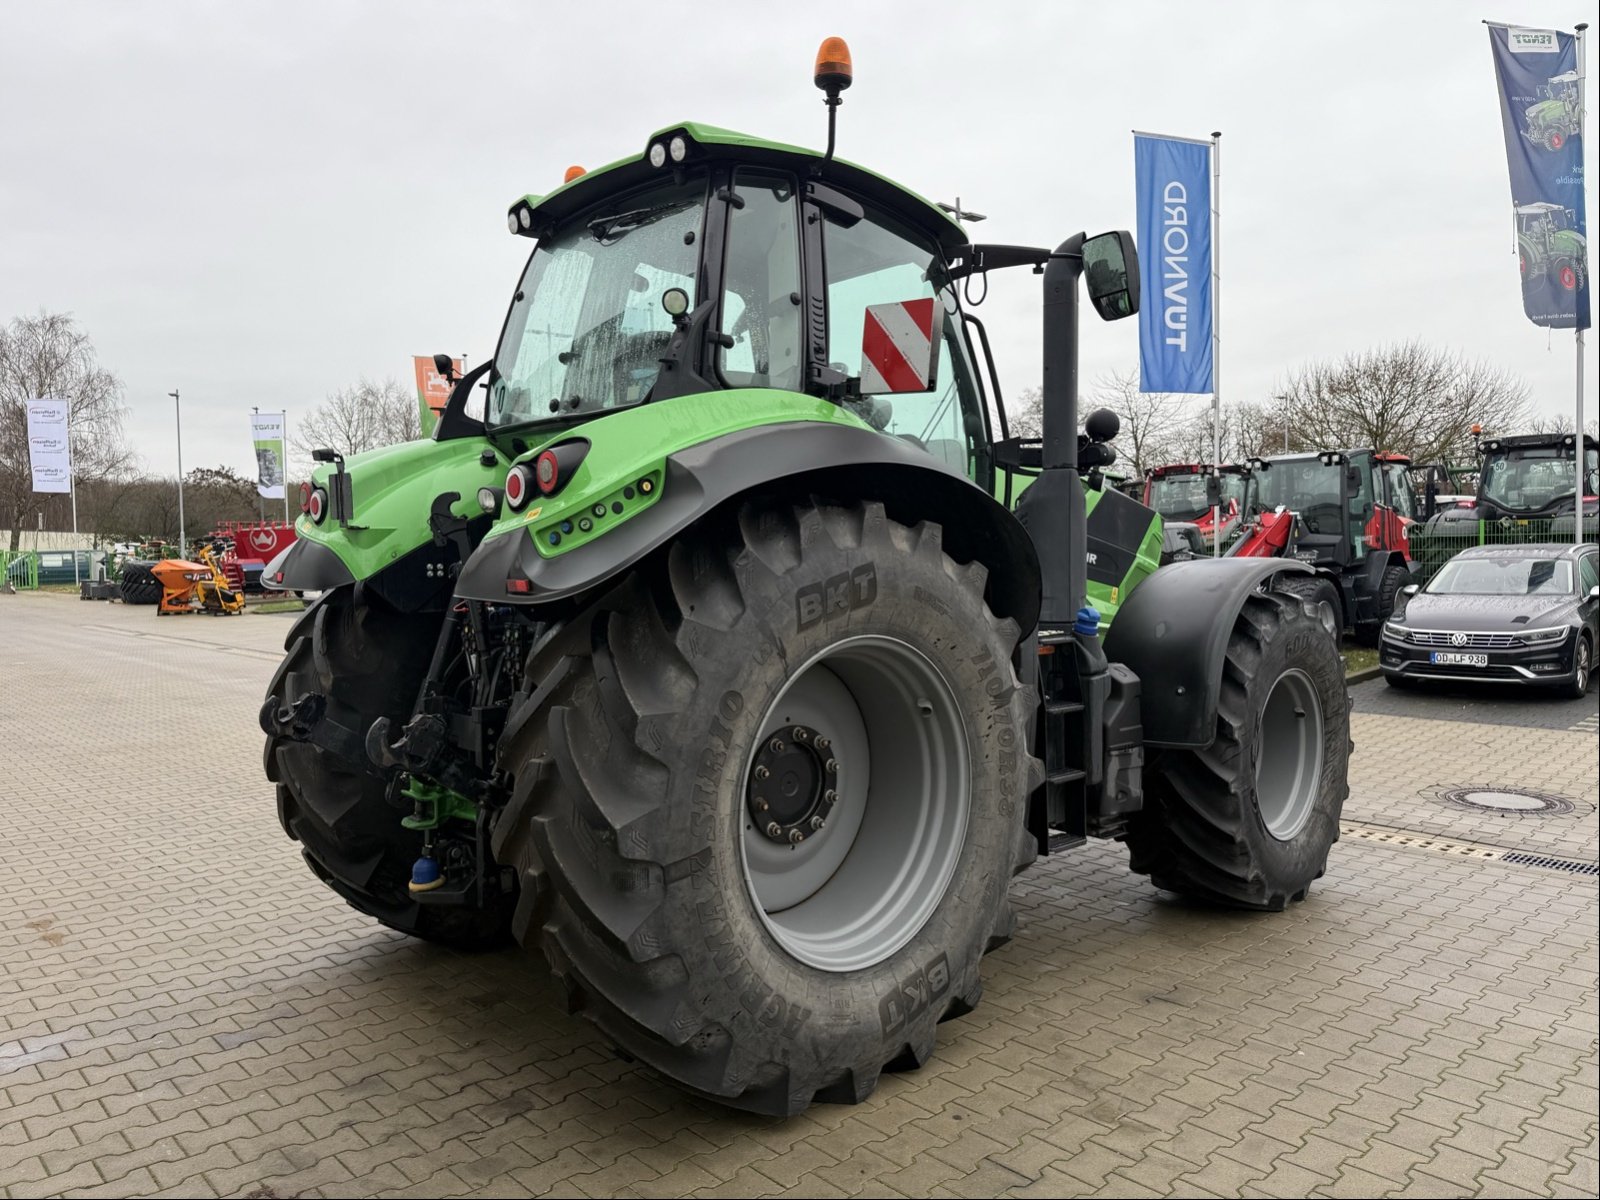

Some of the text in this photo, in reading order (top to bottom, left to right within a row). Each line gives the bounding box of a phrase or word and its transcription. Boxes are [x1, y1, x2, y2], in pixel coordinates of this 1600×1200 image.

[1495, 462, 1505, 471] 50
[796, 562, 877, 633] BKT
[1467, 655, 1487, 665] 938
[690, 689, 745, 843] SIRIO
[878, 950, 950, 1043] BKT
